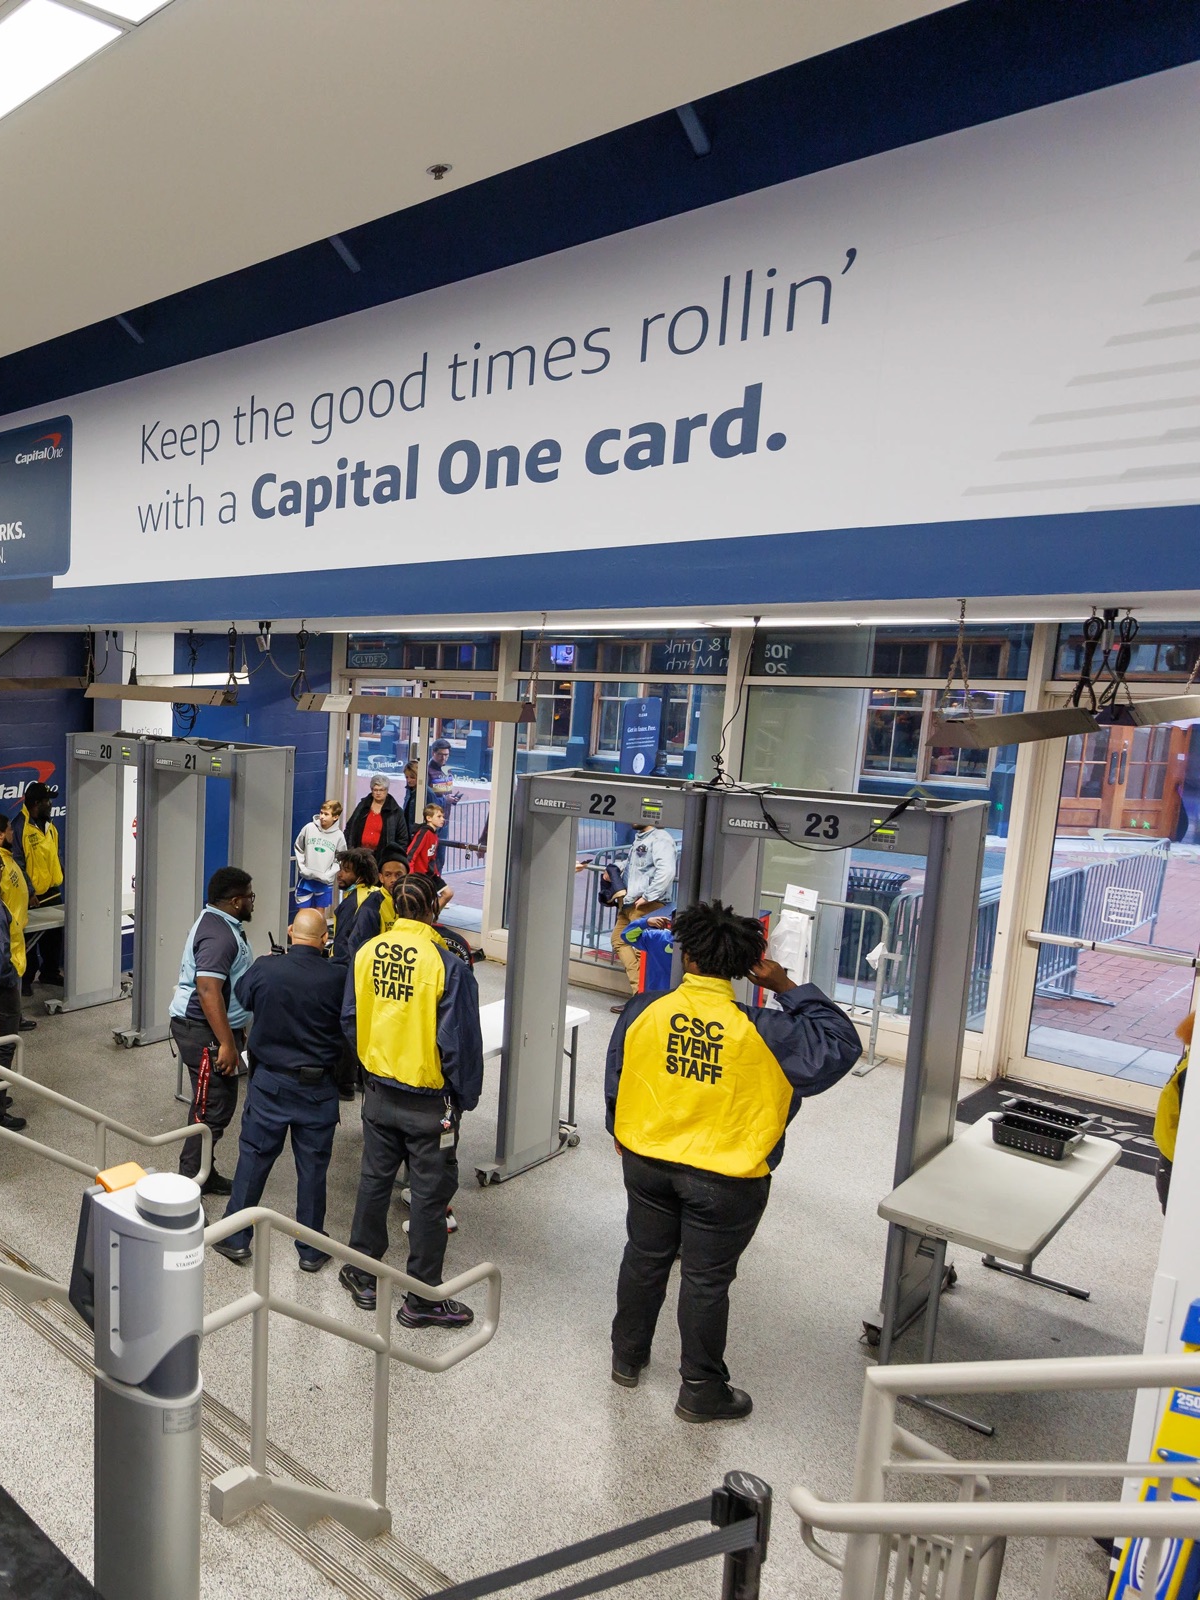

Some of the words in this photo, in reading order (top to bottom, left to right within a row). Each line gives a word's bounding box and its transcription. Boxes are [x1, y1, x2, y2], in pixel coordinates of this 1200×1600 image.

[141, 418, 220, 466] Keep
[233, 394, 295, 446] the
[310, 351, 428, 445] good
[448, 326, 611, 402] times
[137, 483, 204, 534] with
[218, 490, 237, 525] a
[251, 443, 420, 528] Capital
[438, 438, 562, 496] One
[585, 382, 787, 476] card.
[100, 744, 112, 760] 20
[184, 753, 197, 770] 21
[534, 798, 567, 809] GARRETT
[588, 793, 617, 817] 22
[728, 818, 769, 830] GARRETT
[804, 812, 840, 840] 23
[375, 942, 418, 965] CSC
[372, 959, 415, 984] EVENT
[373, 978, 414, 1002] STAFF
[670, 1013, 725, 1042] CSC
[666, 1032, 724, 1064] EVENT
[666, 1054, 723, 1085] STAFF
[925, 1225, 954, 1239] CSC
